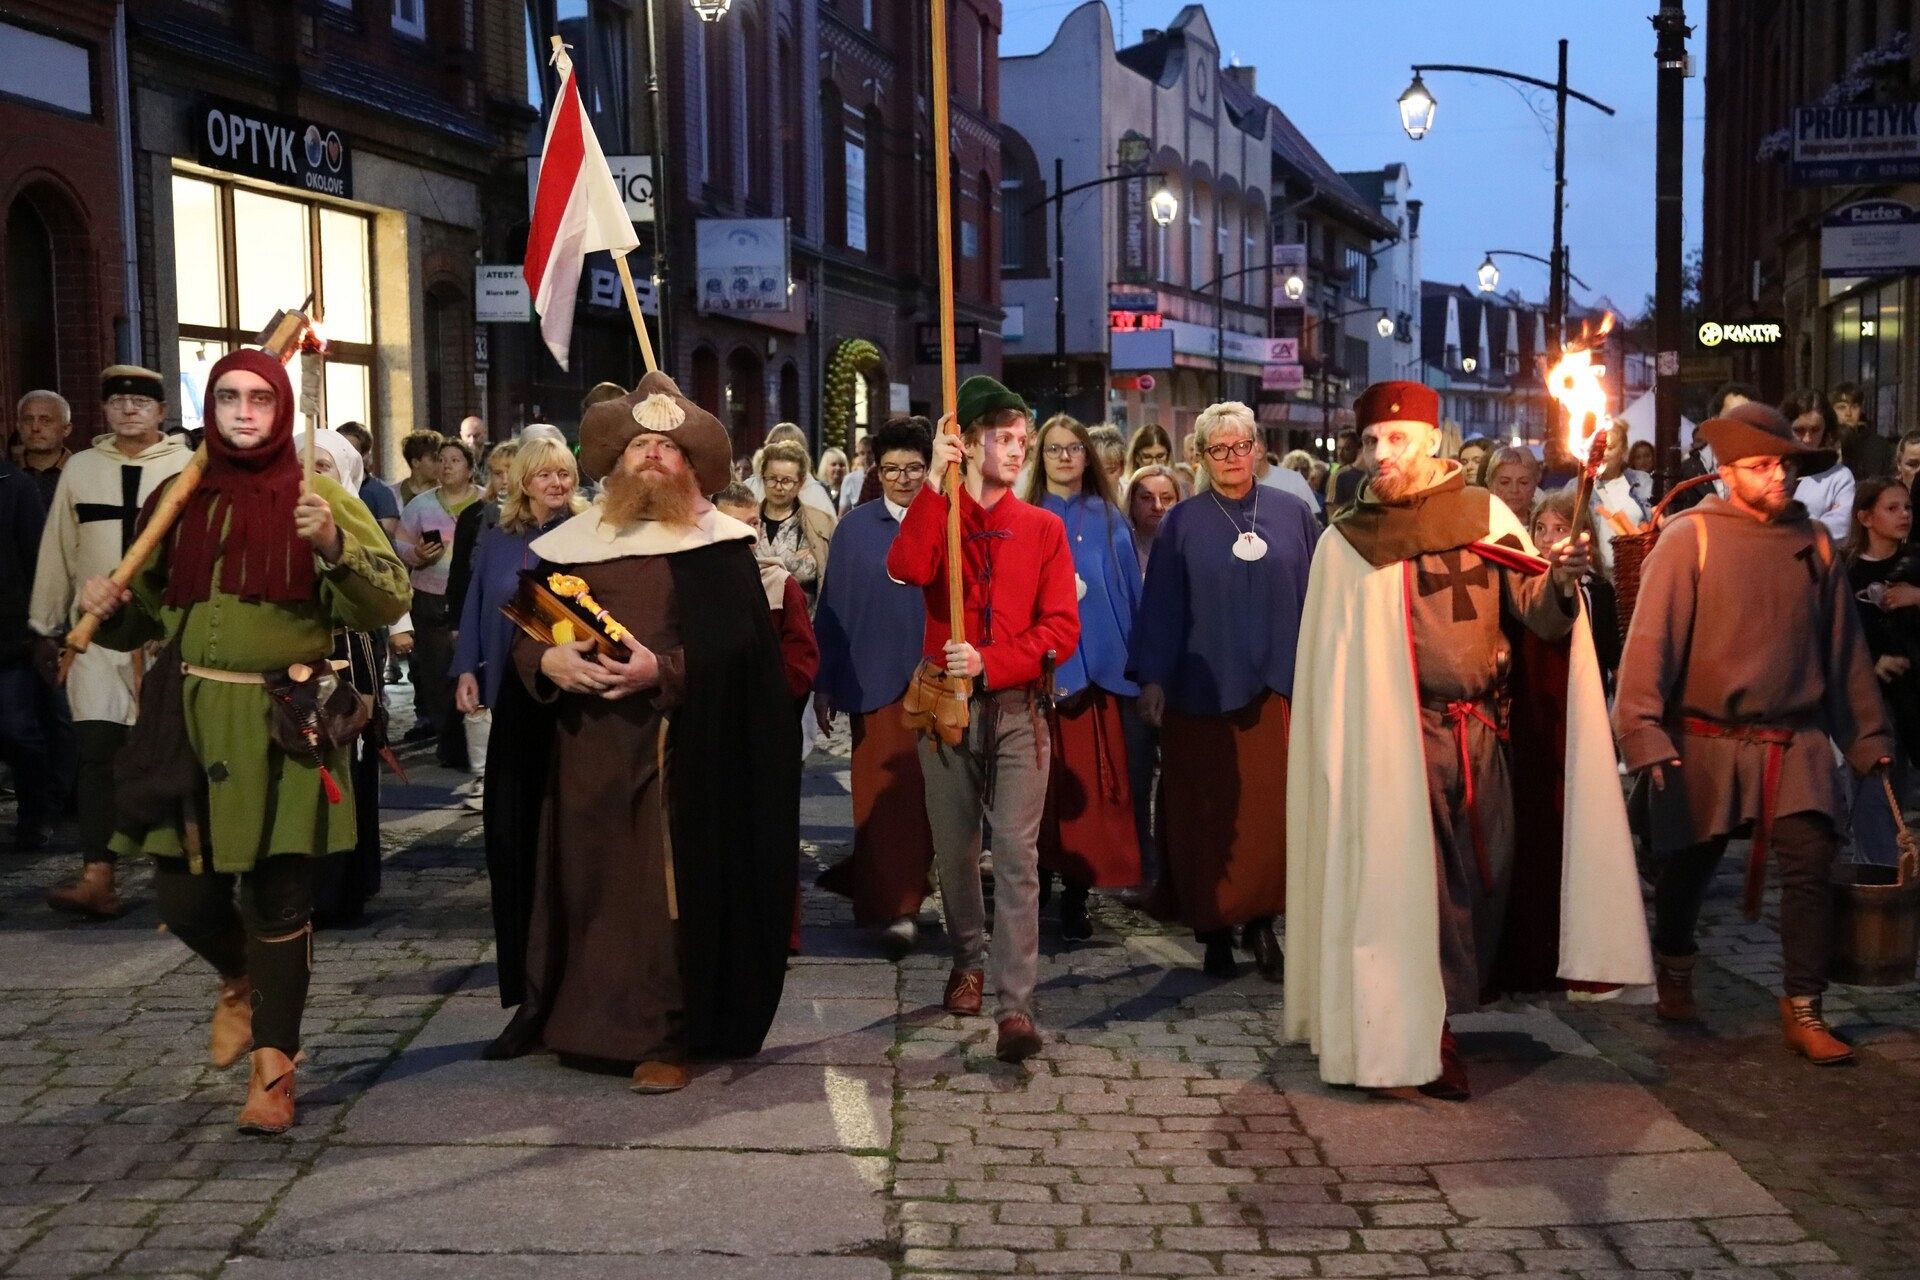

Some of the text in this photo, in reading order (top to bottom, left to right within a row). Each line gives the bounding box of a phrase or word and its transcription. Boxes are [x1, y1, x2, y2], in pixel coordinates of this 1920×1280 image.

[207, 109, 298, 174] OPTYK
[306, 171, 343, 195] OKOLOVE
[1723, 324, 1781, 342] KANTOR
